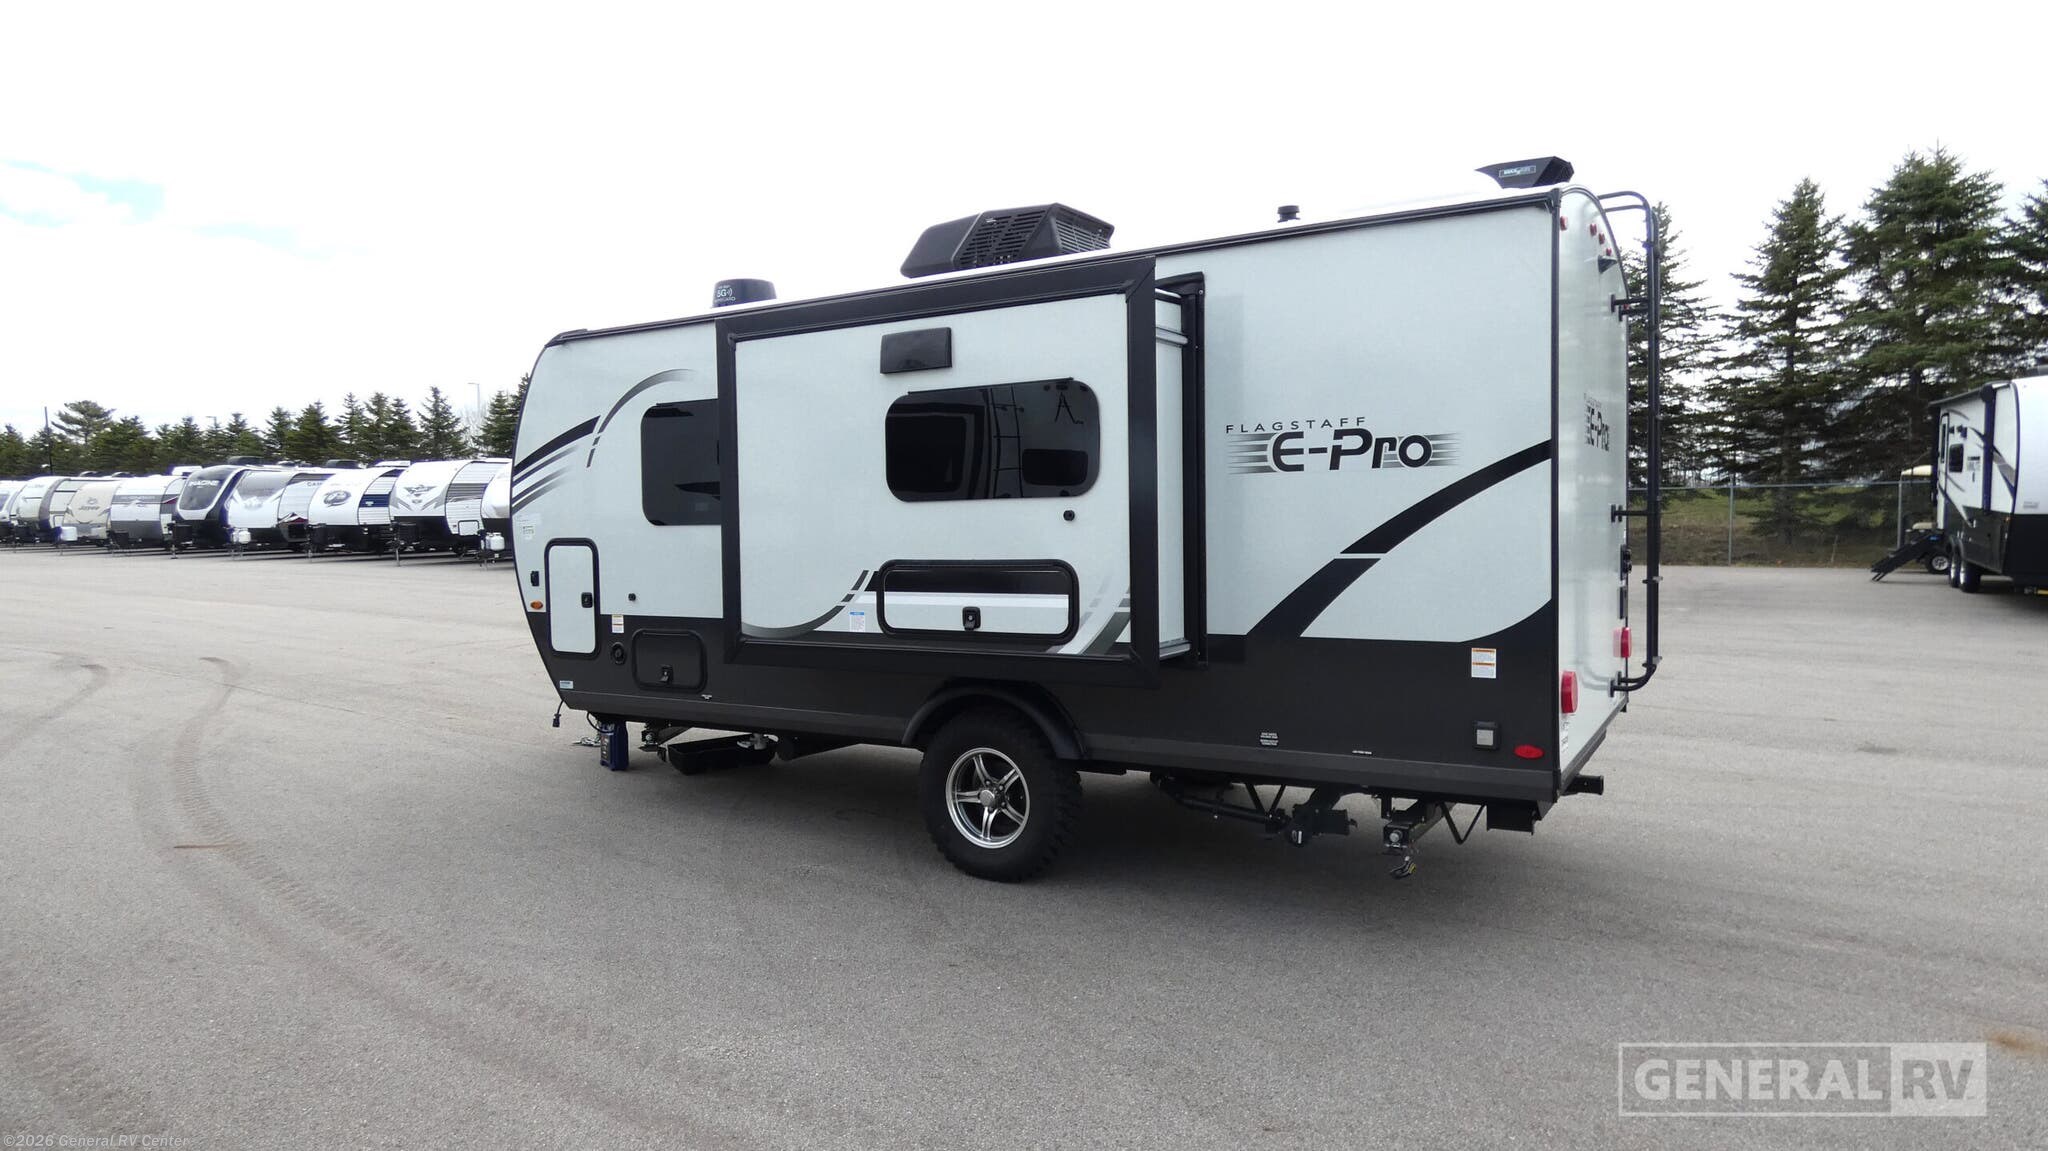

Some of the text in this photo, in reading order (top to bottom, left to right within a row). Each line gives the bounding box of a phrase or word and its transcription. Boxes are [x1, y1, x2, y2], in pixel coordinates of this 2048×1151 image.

[716, 289, 727, 298] 5G
[1226, 416, 1366, 434] FLAGSTAFF
[1272, 428, 1433, 472] E-Pro
